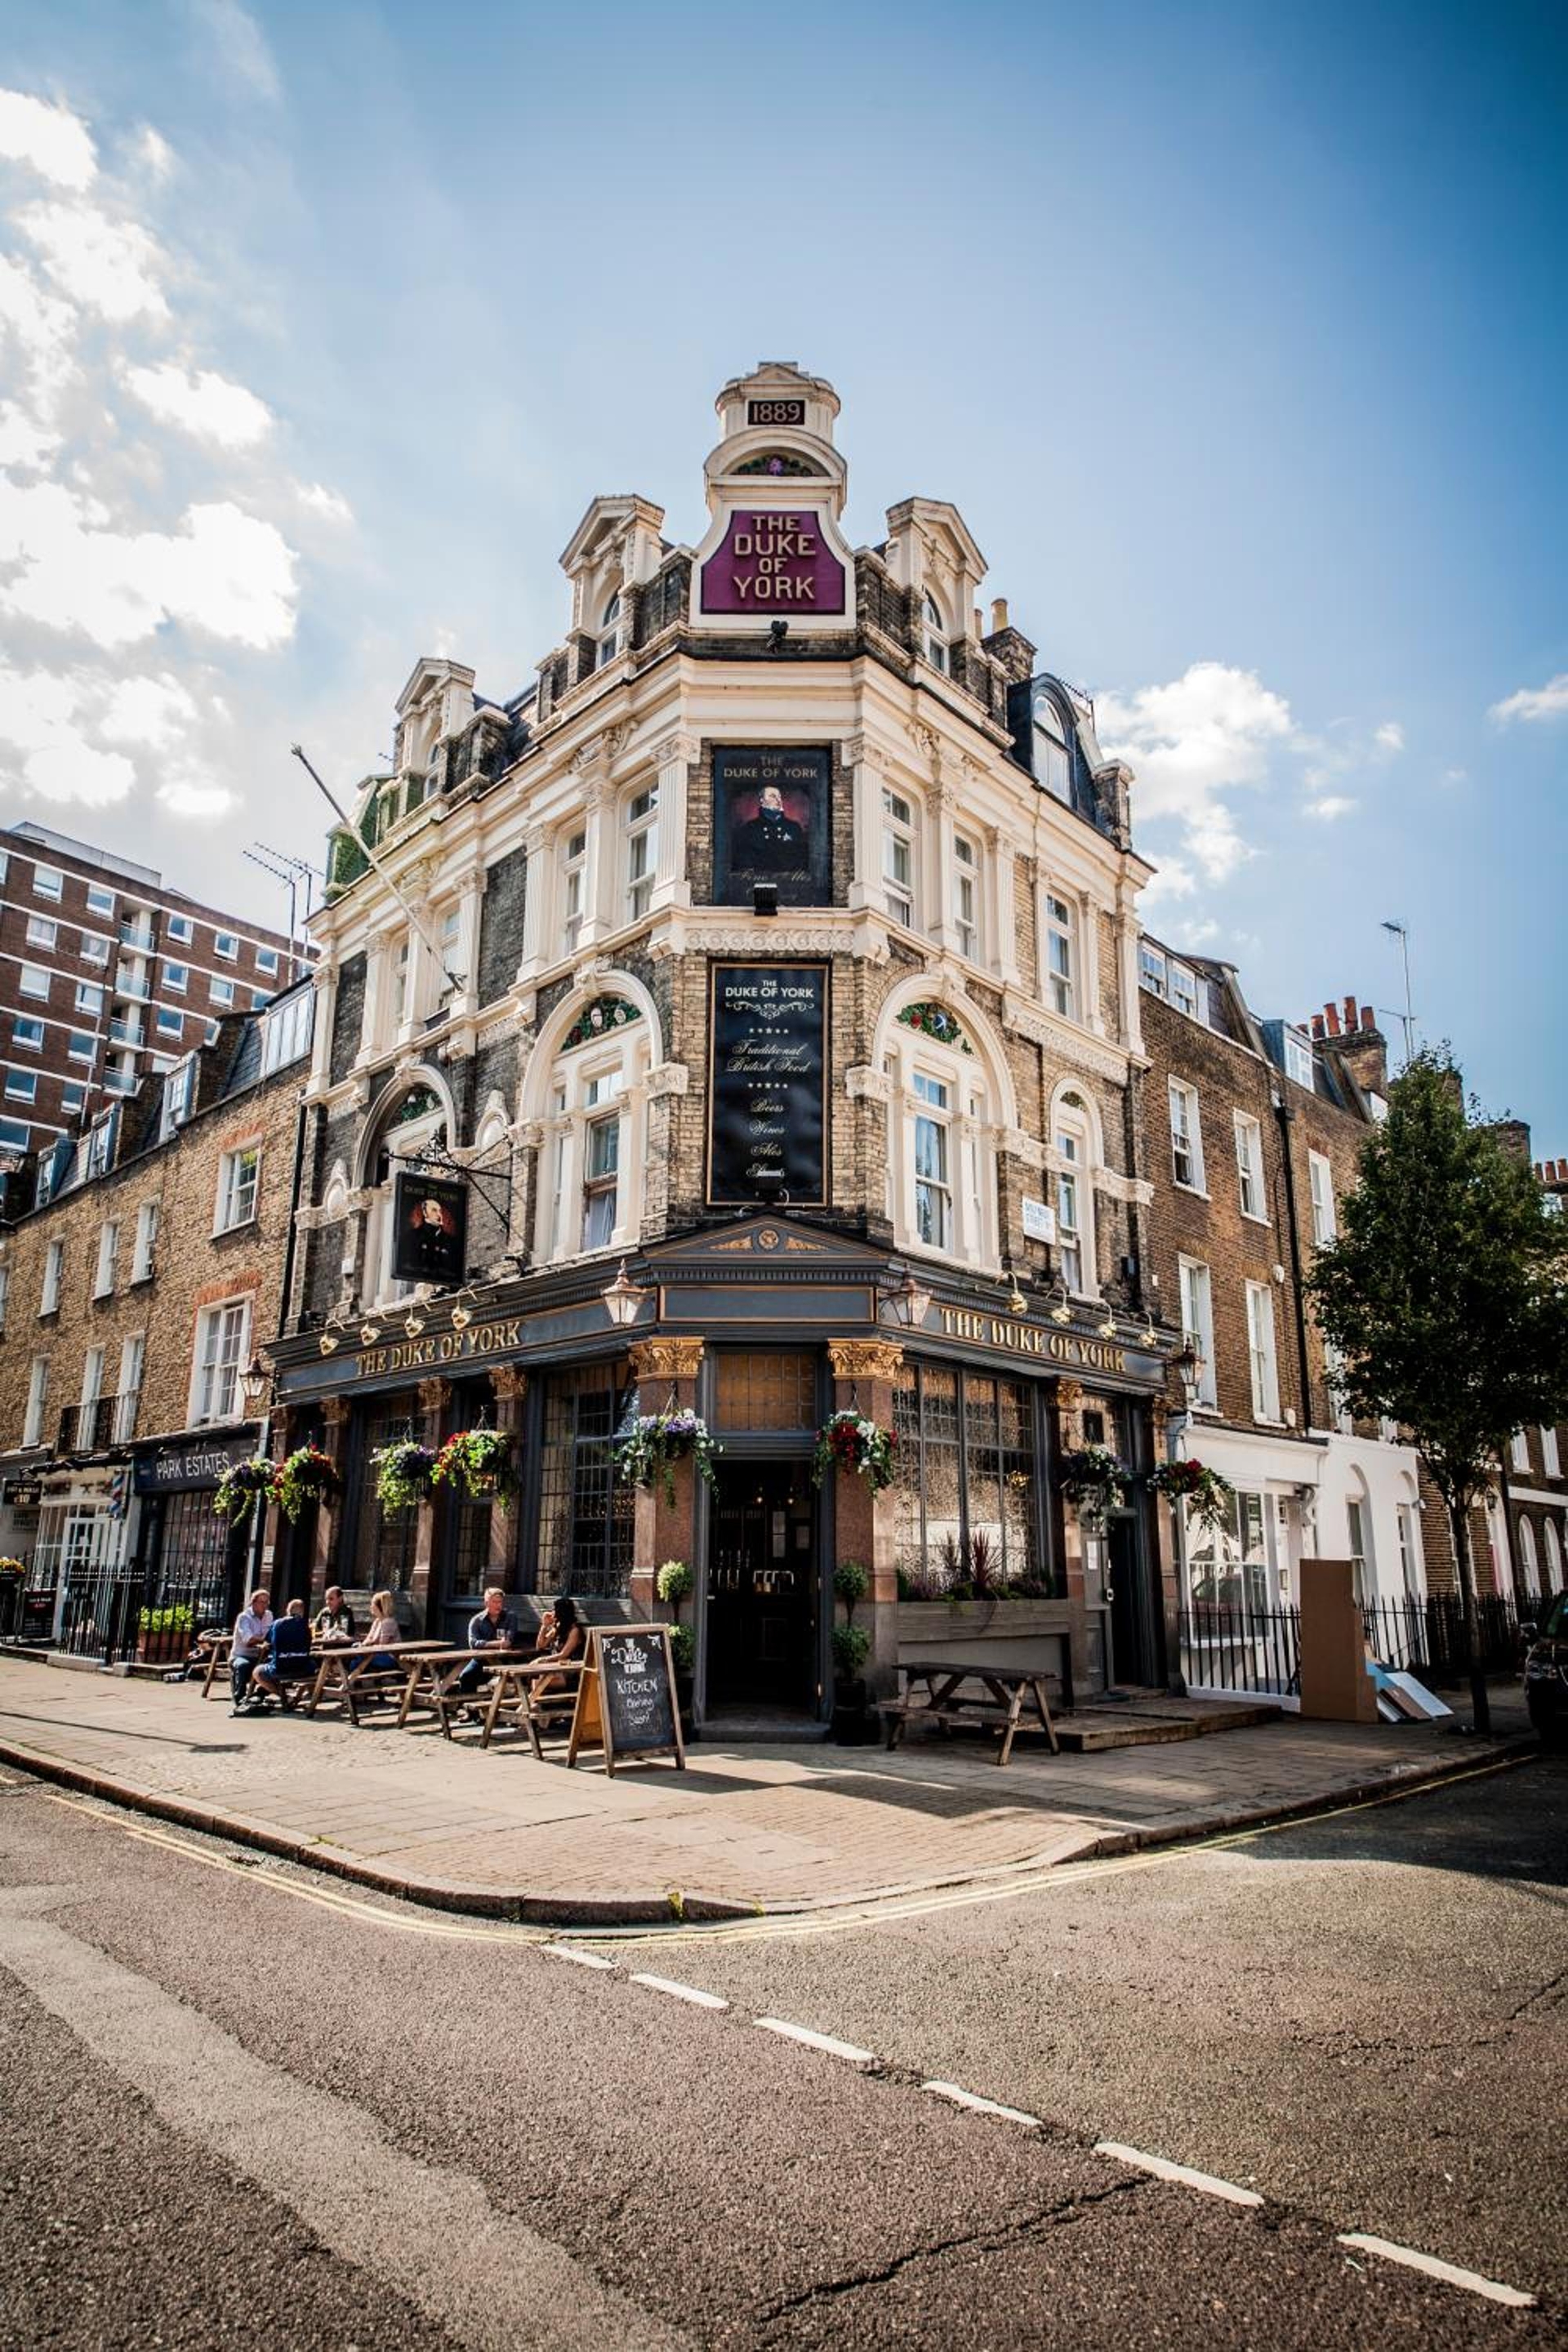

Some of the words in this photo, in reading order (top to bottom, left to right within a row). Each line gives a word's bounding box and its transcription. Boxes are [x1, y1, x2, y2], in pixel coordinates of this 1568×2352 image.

[753, 403, 800, 422] 1889
[752, 515, 800, 531] THE
[735, 534, 816, 556] DUKE
[759, 558, 788, 573] OF
[733, 576, 815, 599] YORK
[760, 755, 784, 766] THE
[724, 768, 758, 778] DUKE
[762, 768, 779, 778] OF
[784, 768, 817, 778] YORK
[725, 987, 758, 997] DUKE
[760, 987, 778, 998] OF
[781, 987, 814, 998] YORK
[732, 1039, 808, 1056] Traditional
[726, 1057, 774, 1072] British
[777, 1056, 813, 1072] Food
[940, 1307, 985, 1341] THE
[990, 1320, 1045, 1354] DUKE
[1049, 1334, 1075, 1361] OF
[1076, 1341, 1127, 1372] YORK
[355, 1349, 386, 1377] THE
[390, 1339, 436, 1370] DUKE
[440, 1333, 464, 1359] OF
[467, 1321, 521, 1355] YORK
[156, 1458, 183, 1480] PARK
[185, 1451, 230, 1477] ESTATES
[615, 1677, 658, 1695] KITCHEN
